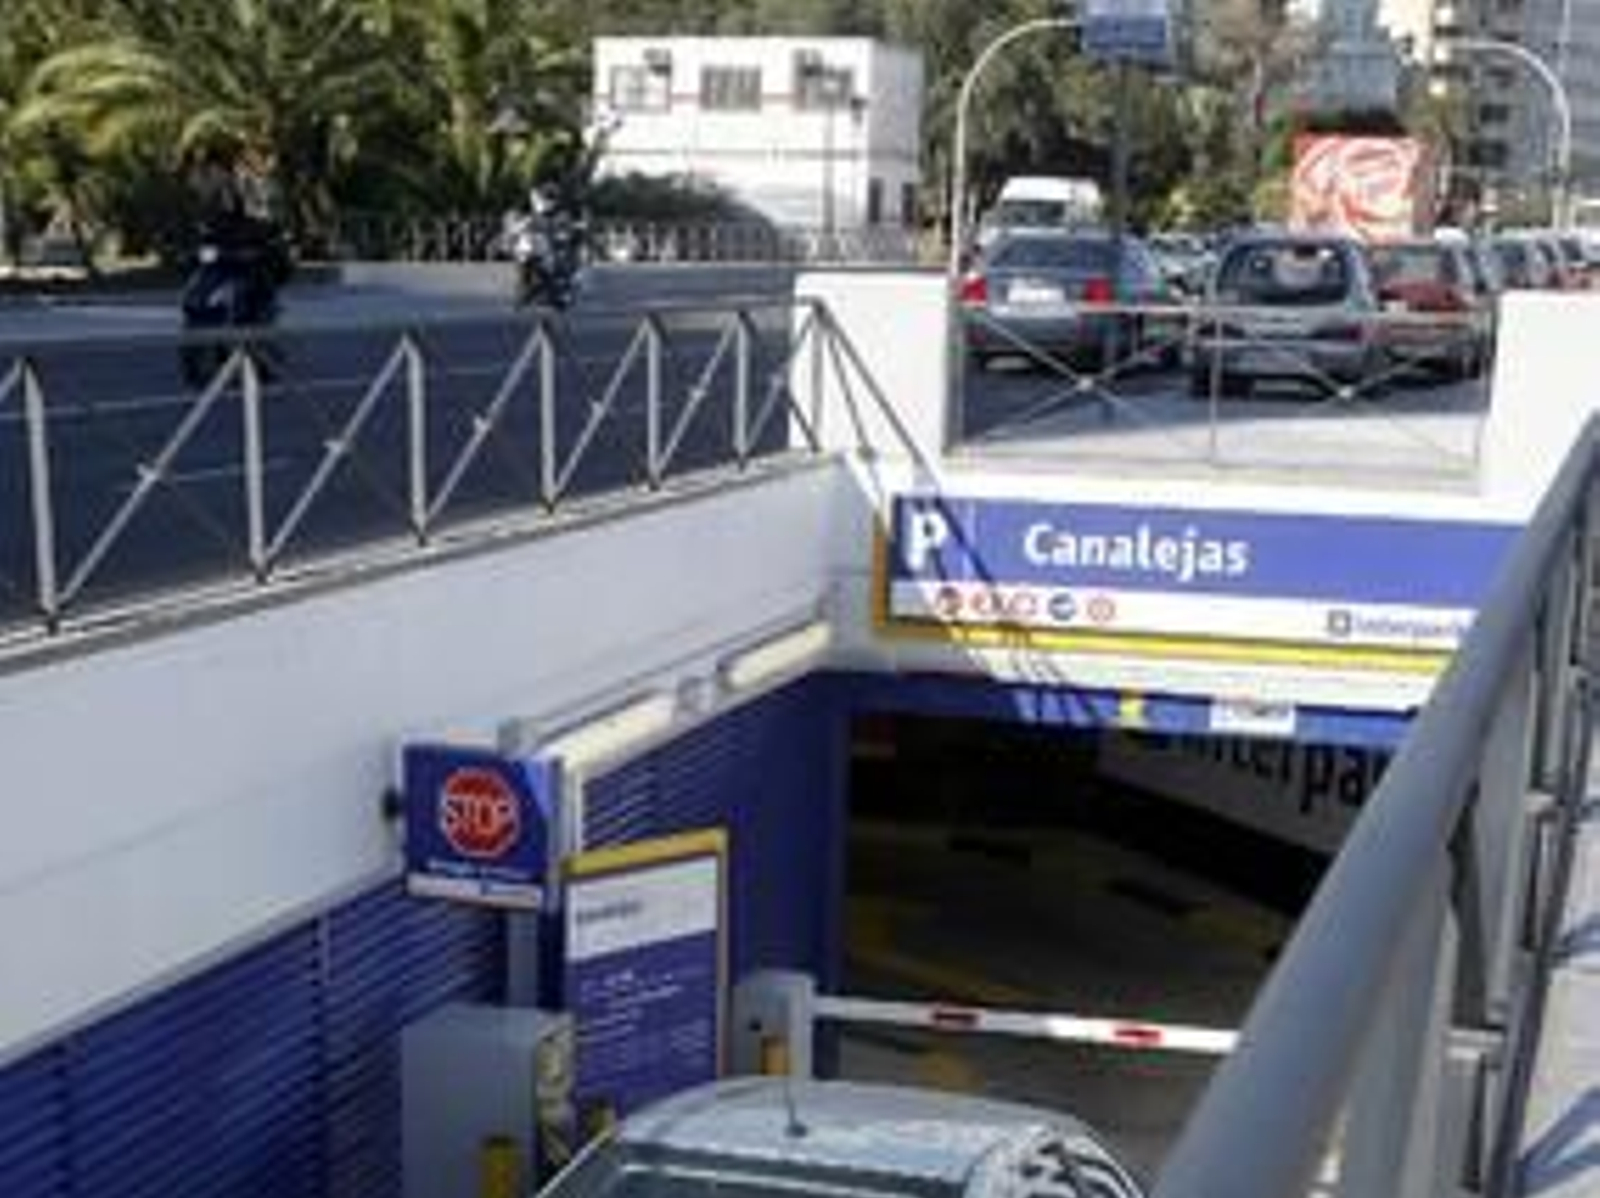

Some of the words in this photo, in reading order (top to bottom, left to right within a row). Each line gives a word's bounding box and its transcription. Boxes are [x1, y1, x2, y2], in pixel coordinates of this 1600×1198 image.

[907, 510, 948, 571] P
[1022, 522, 1249, 583] Canalejas
[441, 796, 518, 834] STOP
